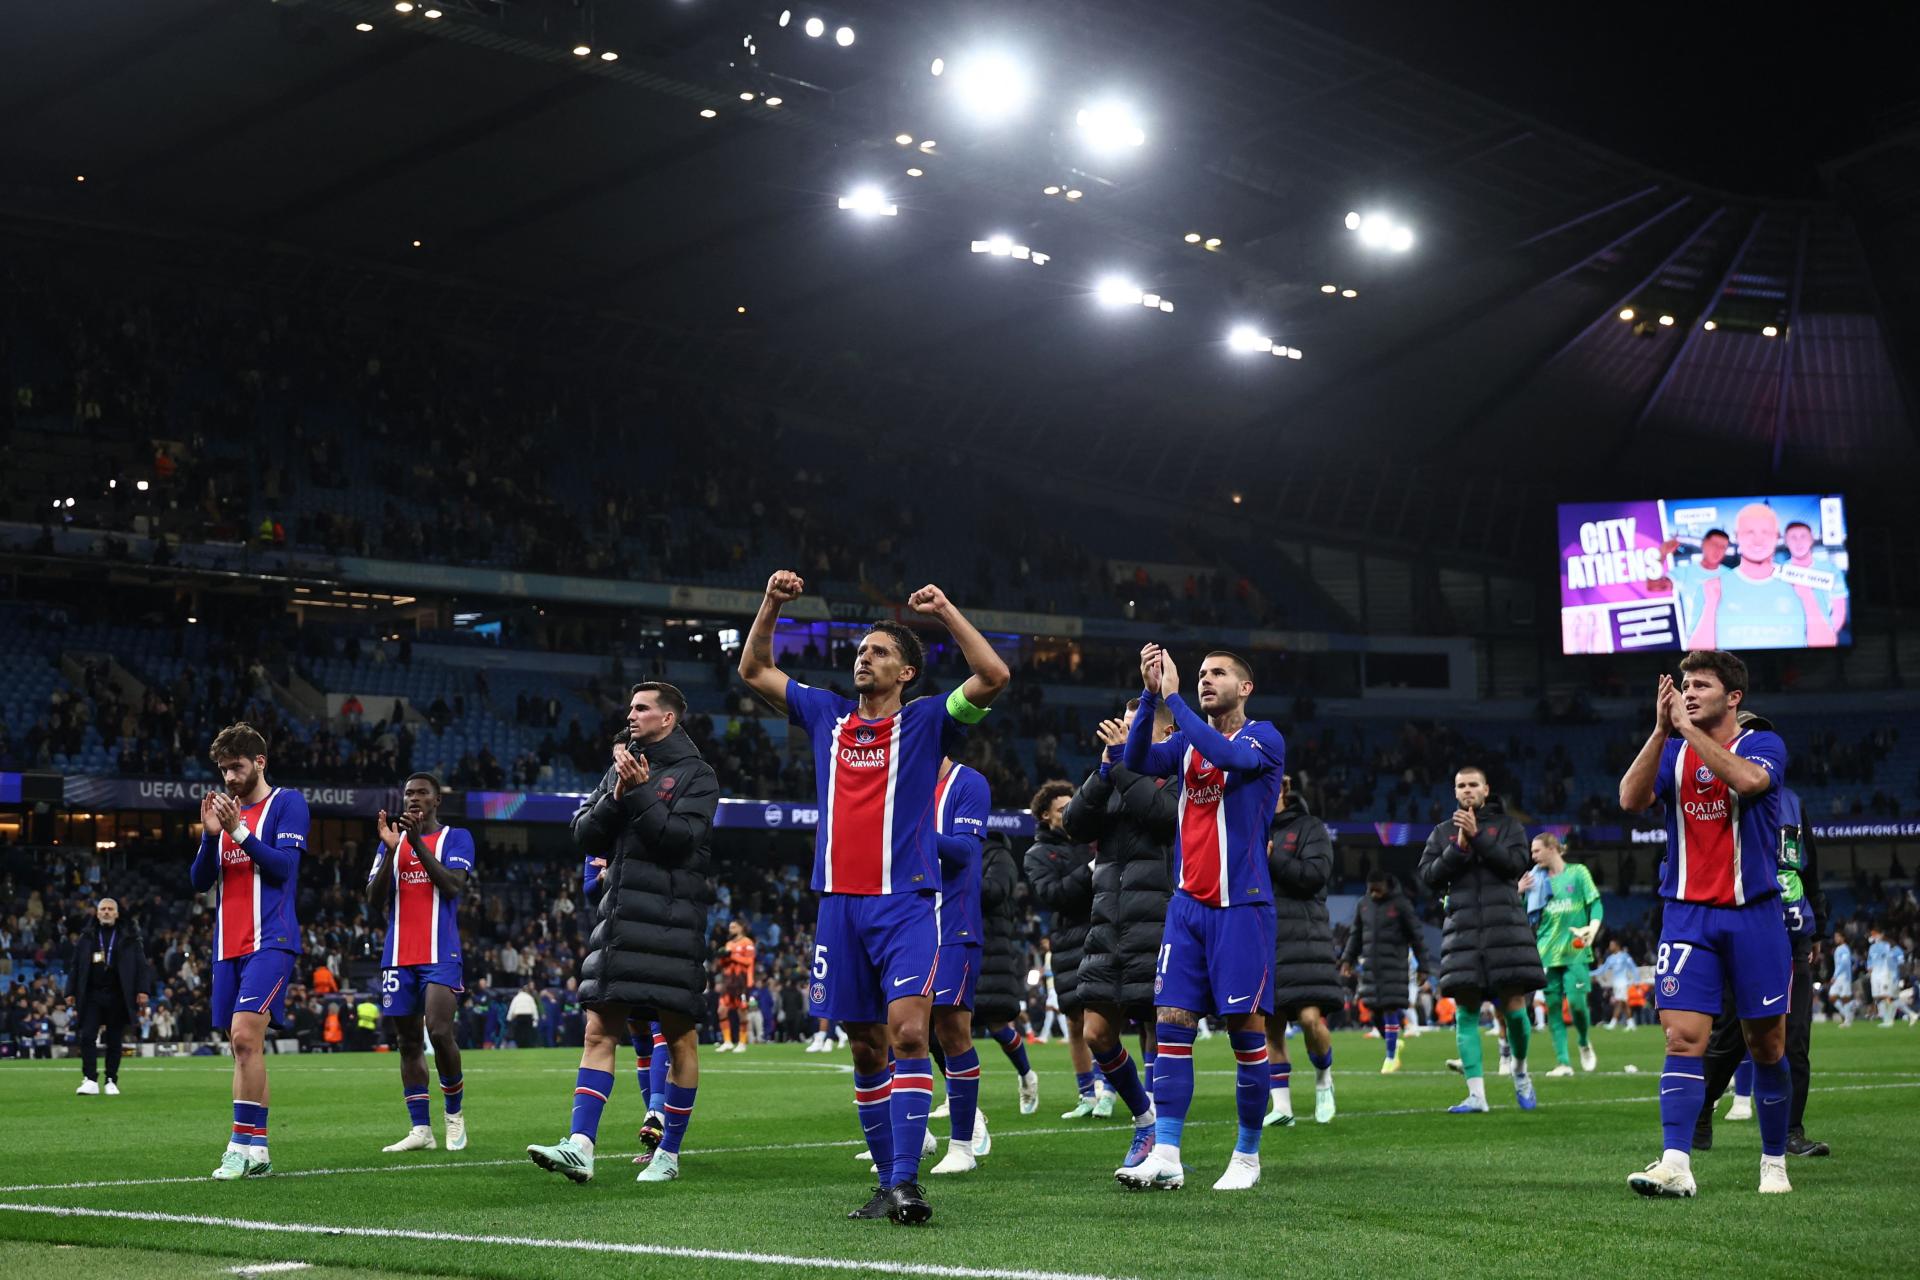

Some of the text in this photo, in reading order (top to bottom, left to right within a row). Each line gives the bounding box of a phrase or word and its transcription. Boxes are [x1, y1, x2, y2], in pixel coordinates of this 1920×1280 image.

[1579, 517, 1636, 555] CITY
[1567, 547, 1663, 590] ATHENS
[840, 748, 886, 763] QATAR
[139, 782, 185, 799] UEFA
[303, 787, 355, 805] EAGUE
[1186, 784, 1222, 799] QATAR
[1683, 800, 1726, 815] QATAR
[792, 809, 819, 824] PEP
[954, 817, 983, 827] BEYOND
[1695, 811, 1728, 821] AIRWAYS
[277, 832, 305, 842] BEYOND
[1827, 824, 1899, 837] CHAMPIONS
[1901, 823, 1920, 836] LEA
[223, 849, 247, 861] QATA
[1782, 906, 1804, 932] 3
[813, 944, 828, 980] 5
[1656, 942, 1693, 975] 87
